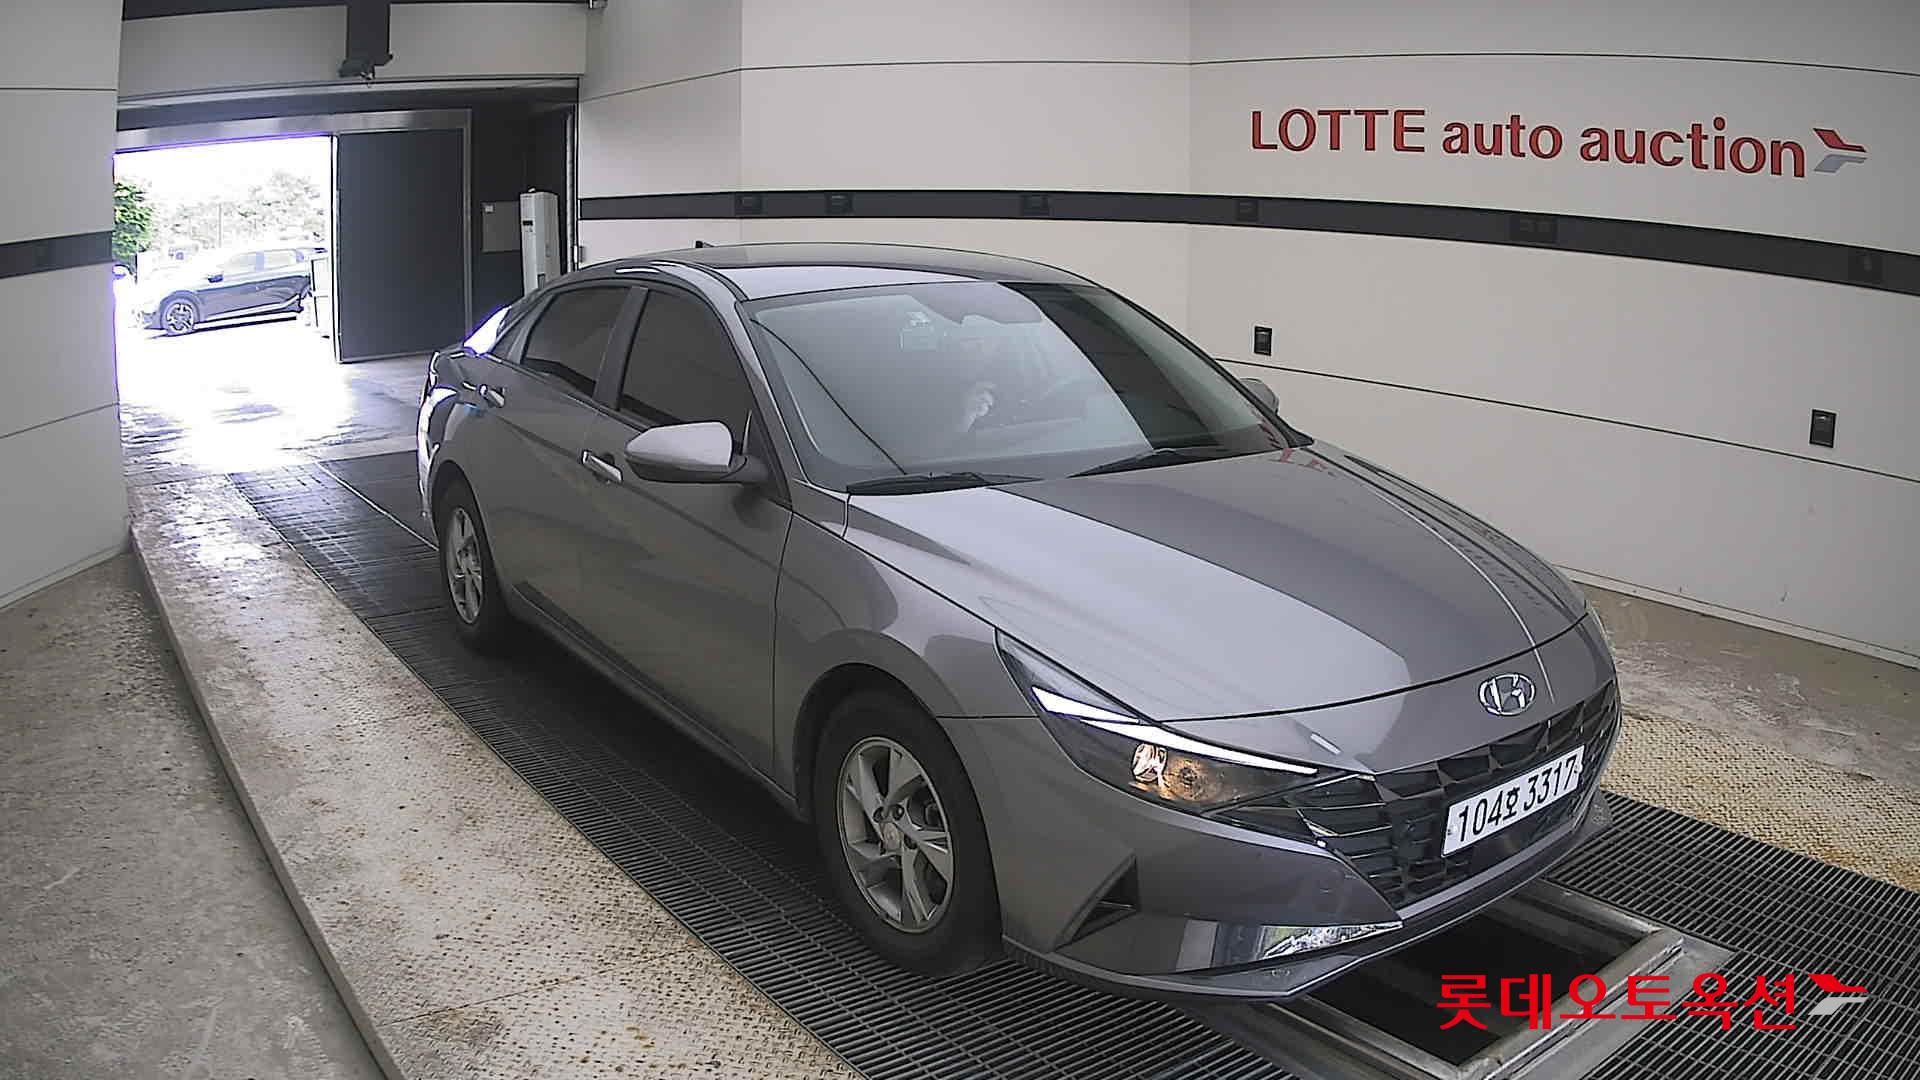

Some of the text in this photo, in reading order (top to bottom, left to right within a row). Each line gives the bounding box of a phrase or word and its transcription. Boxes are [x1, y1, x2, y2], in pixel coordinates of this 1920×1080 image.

[1251, 110, 1807, 178] LOTTE auto auction
[1523, 754, 1578, 812] 3317
